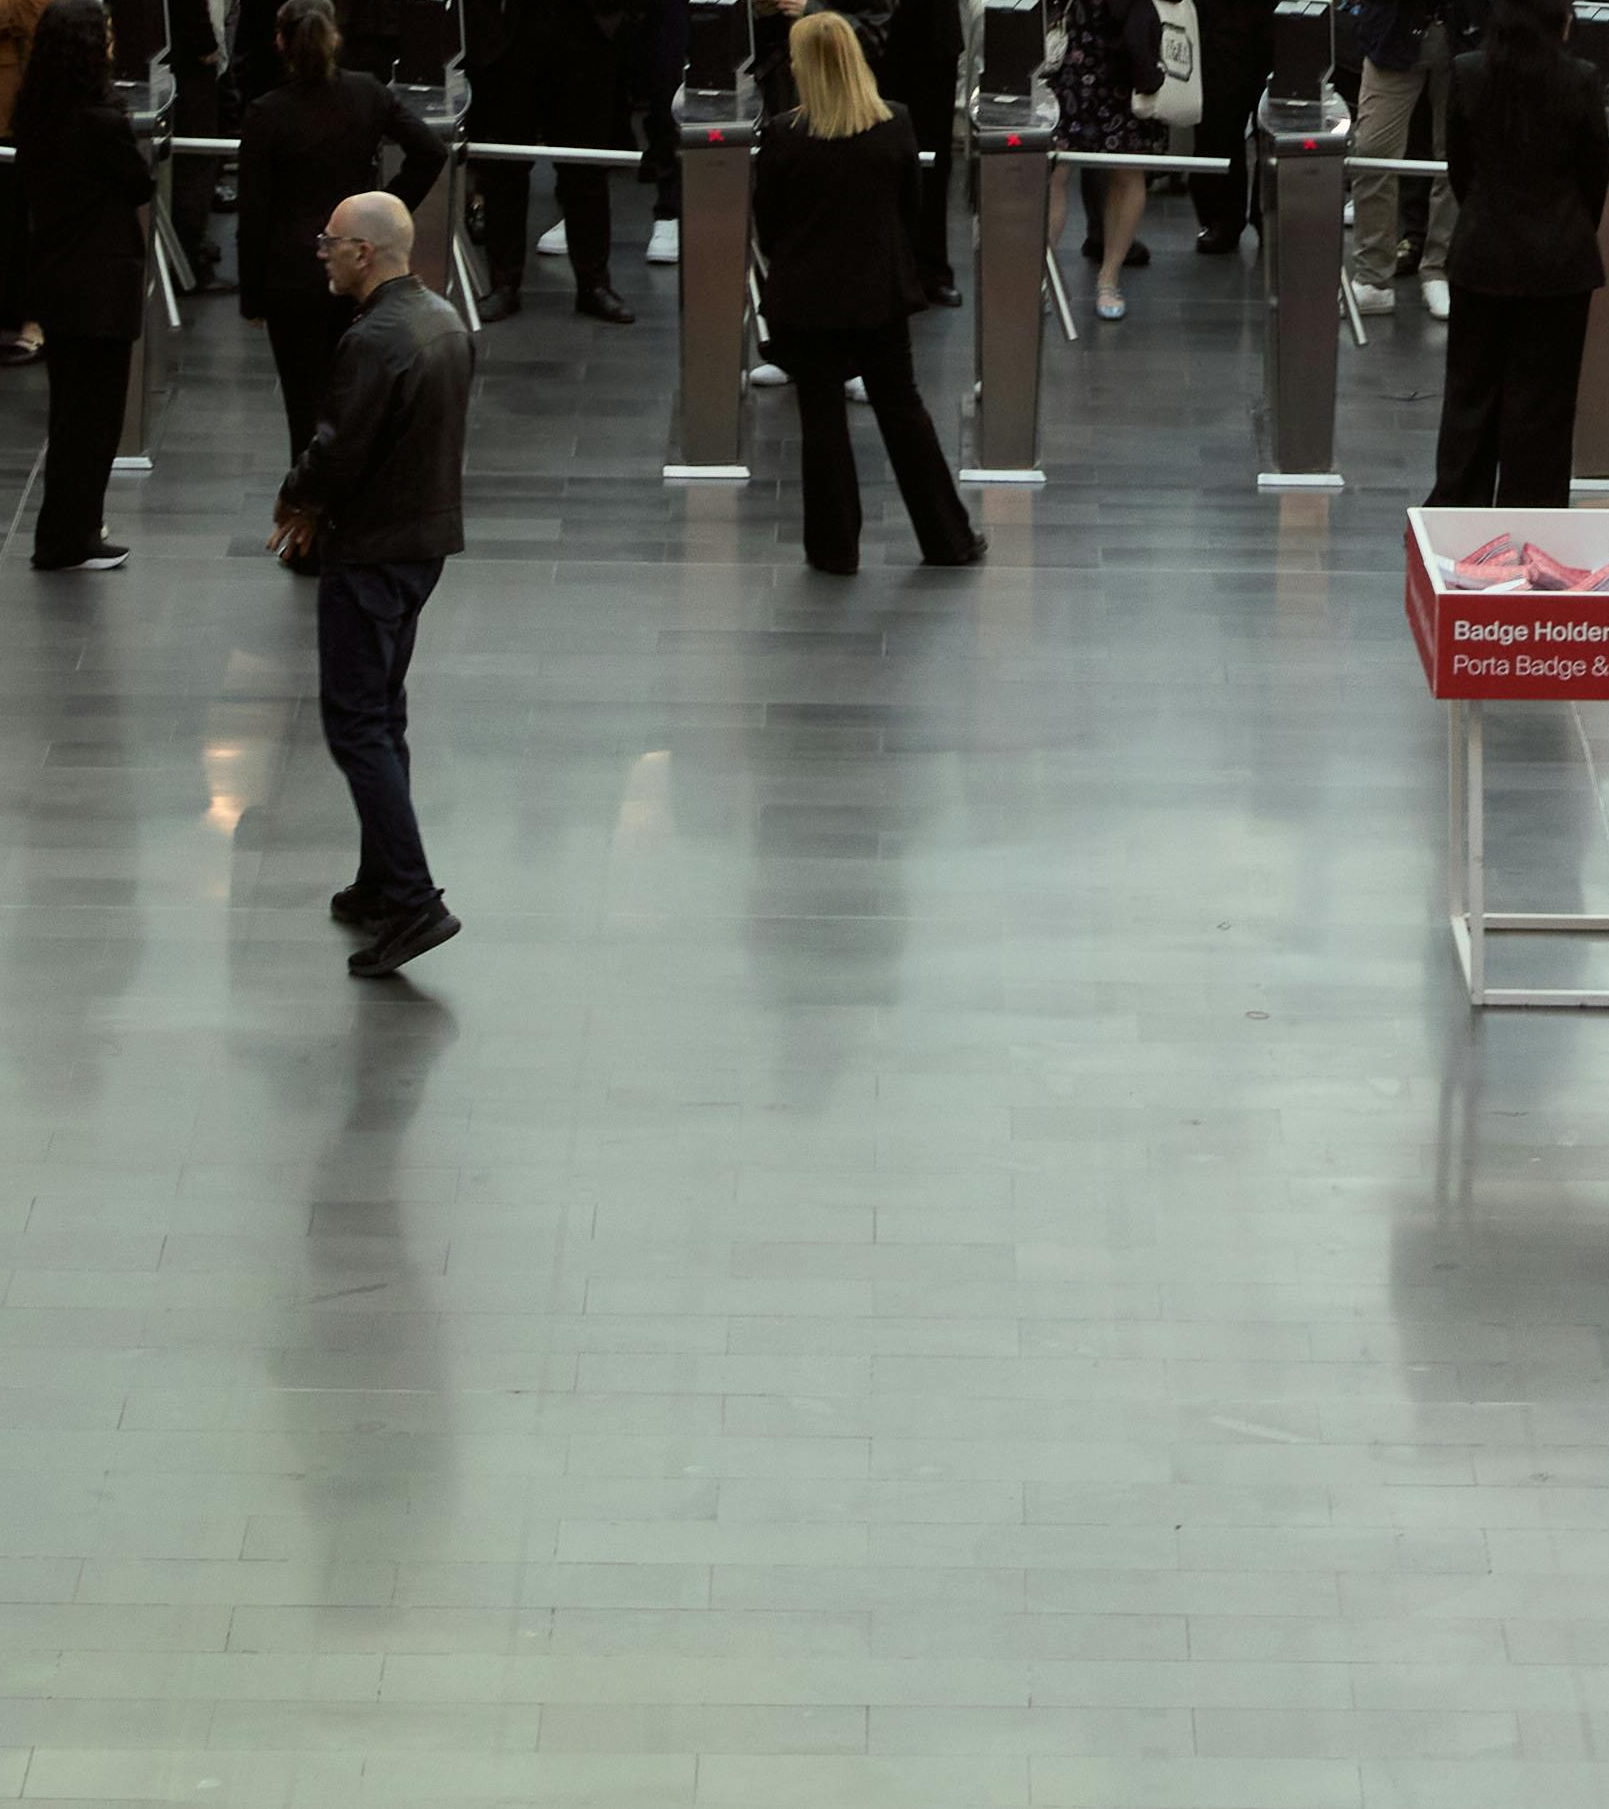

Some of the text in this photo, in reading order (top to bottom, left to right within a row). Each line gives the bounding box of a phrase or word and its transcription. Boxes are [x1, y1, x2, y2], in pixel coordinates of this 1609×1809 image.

[1454, 621, 1529, 646] Badge
[1453, 654, 1510, 676] Porta
[1516, 655, 1587, 681] Badge
[1592, 655, 1609, 676] &
